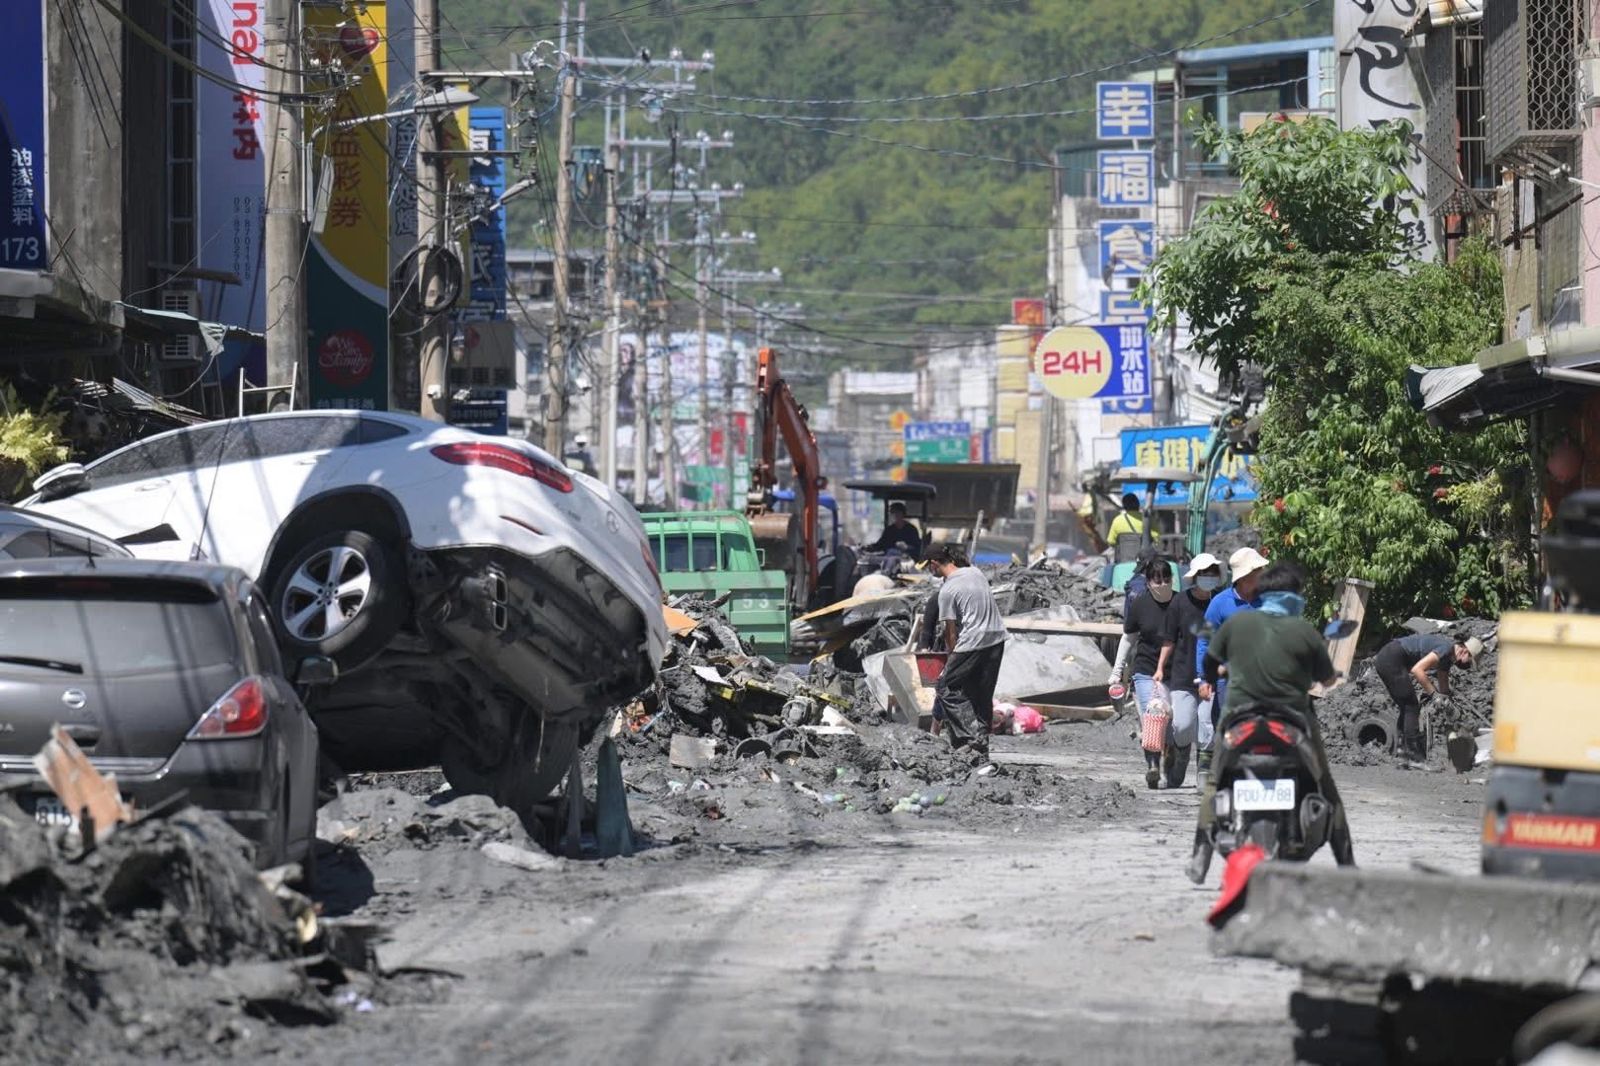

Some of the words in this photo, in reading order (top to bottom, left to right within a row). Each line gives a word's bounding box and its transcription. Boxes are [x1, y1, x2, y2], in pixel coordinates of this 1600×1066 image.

[2, 236, 39, 261] 173
[1043, 351, 1102, 375] 24H
[1119, 326, 1144, 394] 加水站
